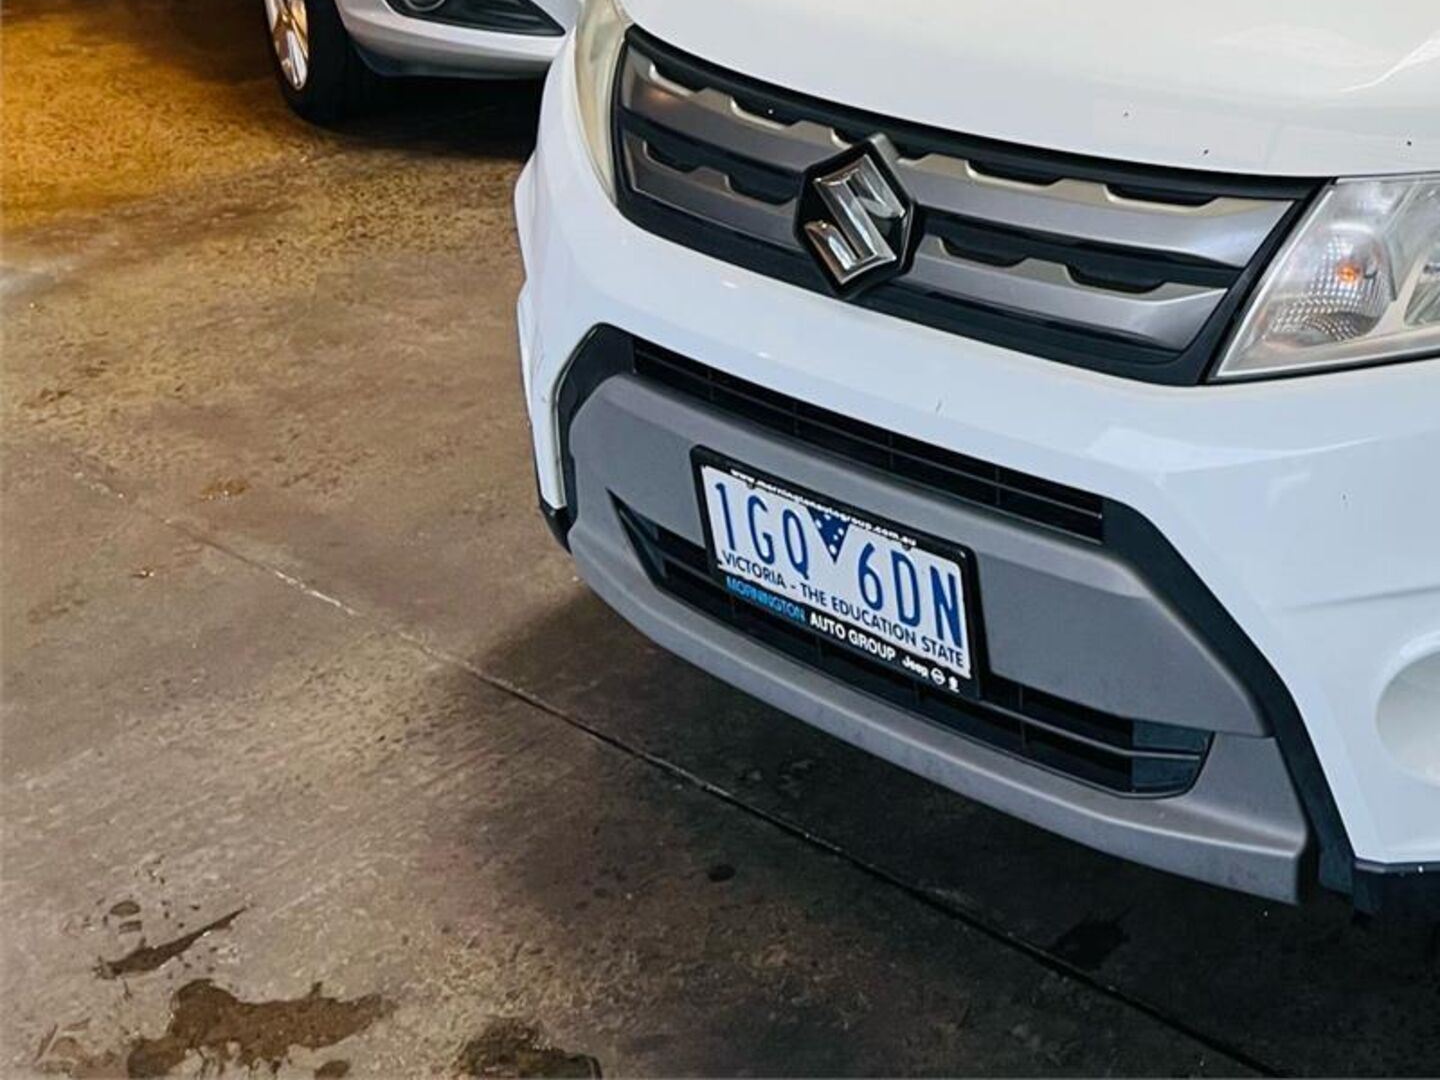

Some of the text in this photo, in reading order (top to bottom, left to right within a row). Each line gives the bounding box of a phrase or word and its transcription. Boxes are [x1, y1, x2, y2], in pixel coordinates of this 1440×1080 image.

[715, 482, 962, 649] 1GQ 6DN
[721, 549, 787, 591] VICTORIA
[800, 583, 828, 608] THE
[831, 592, 917, 648] EDUCATION
[921, 634, 964, 668] STATE
[725, 575, 930, 679] MORNINGTON AUTO GROUP Jeep
